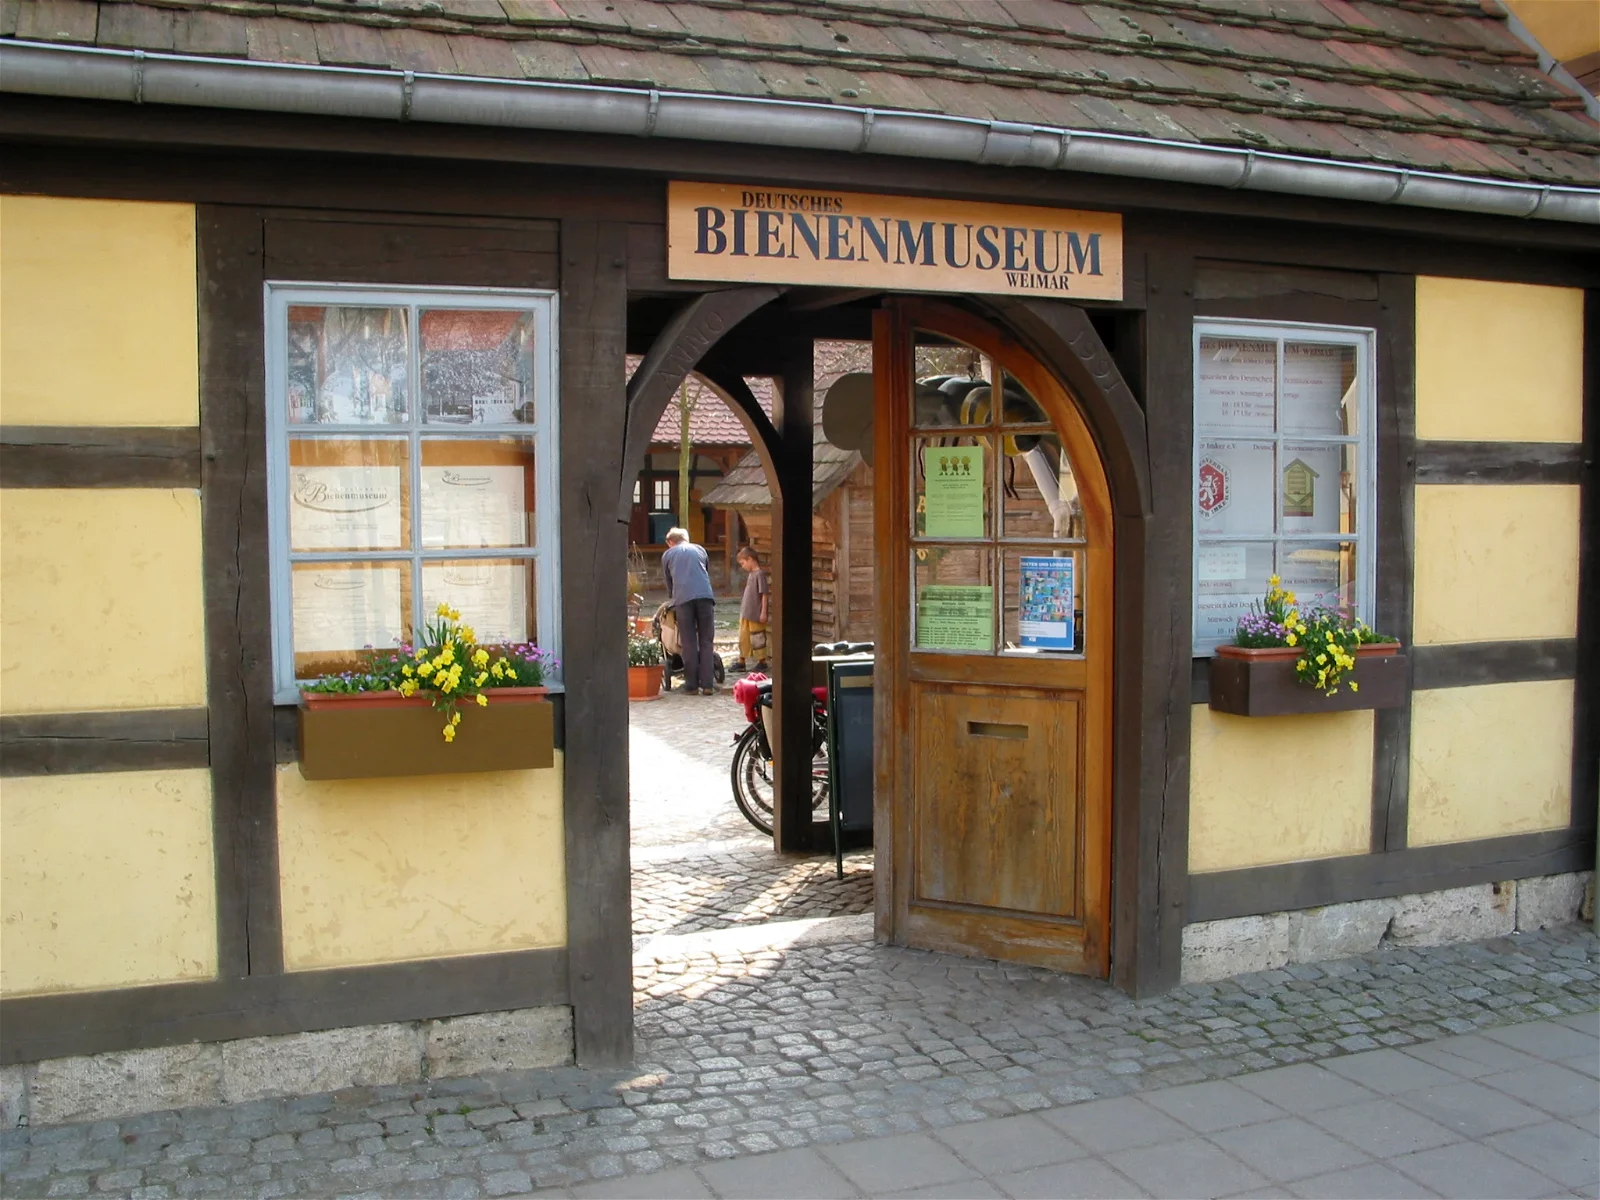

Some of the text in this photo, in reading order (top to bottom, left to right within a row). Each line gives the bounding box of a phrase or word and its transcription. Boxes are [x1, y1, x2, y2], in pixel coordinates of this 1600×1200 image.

[741, 191, 843, 212] DEUTSCHES
[694, 207, 1104, 276] BIENENMUSEUM
[1005, 272, 1070, 290] WEIMAR
[304, 482, 388, 503] Bienenmuseum
